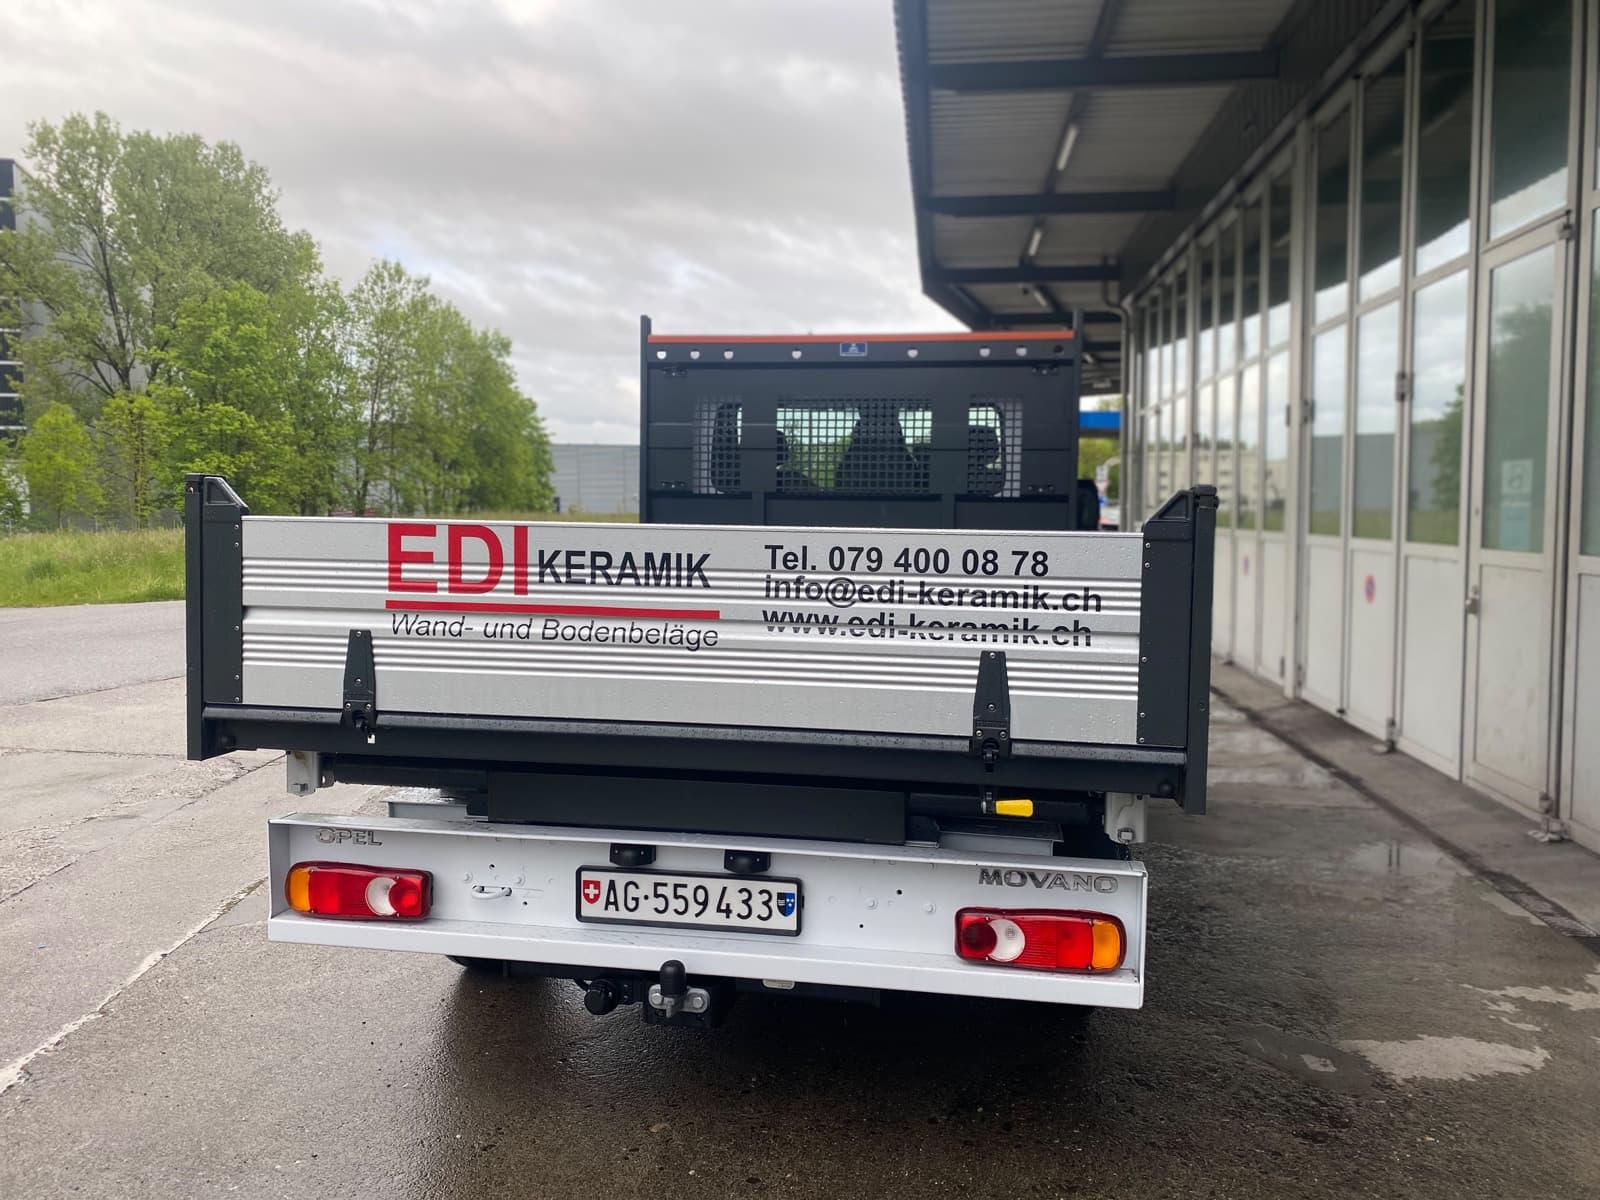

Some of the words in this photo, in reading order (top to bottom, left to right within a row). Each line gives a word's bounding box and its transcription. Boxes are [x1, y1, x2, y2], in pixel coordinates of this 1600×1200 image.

[388, 523, 528, 595] EDI
[538, 550, 712, 588] KERAMIK
[764, 544, 817, 571] Tel.
[828, 546, 883, 572] 079
[893, 548, 950, 574] 400
[961, 549, 999, 576] 08
[1011, 550, 1049, 577] 78
[764, 575, 1102, 612] info@edi-keramik.ch
[392, 613, 474, 637] Wand-
[484, 617, 533, 640] und
[542, 619, 719, 651] Bodenbeläge
[762, 610, 1092, 647] www.edi-keramik.ch
[316, 827, 383, 846] OPEL
[978, 868, 1119, 893] MOVANO
